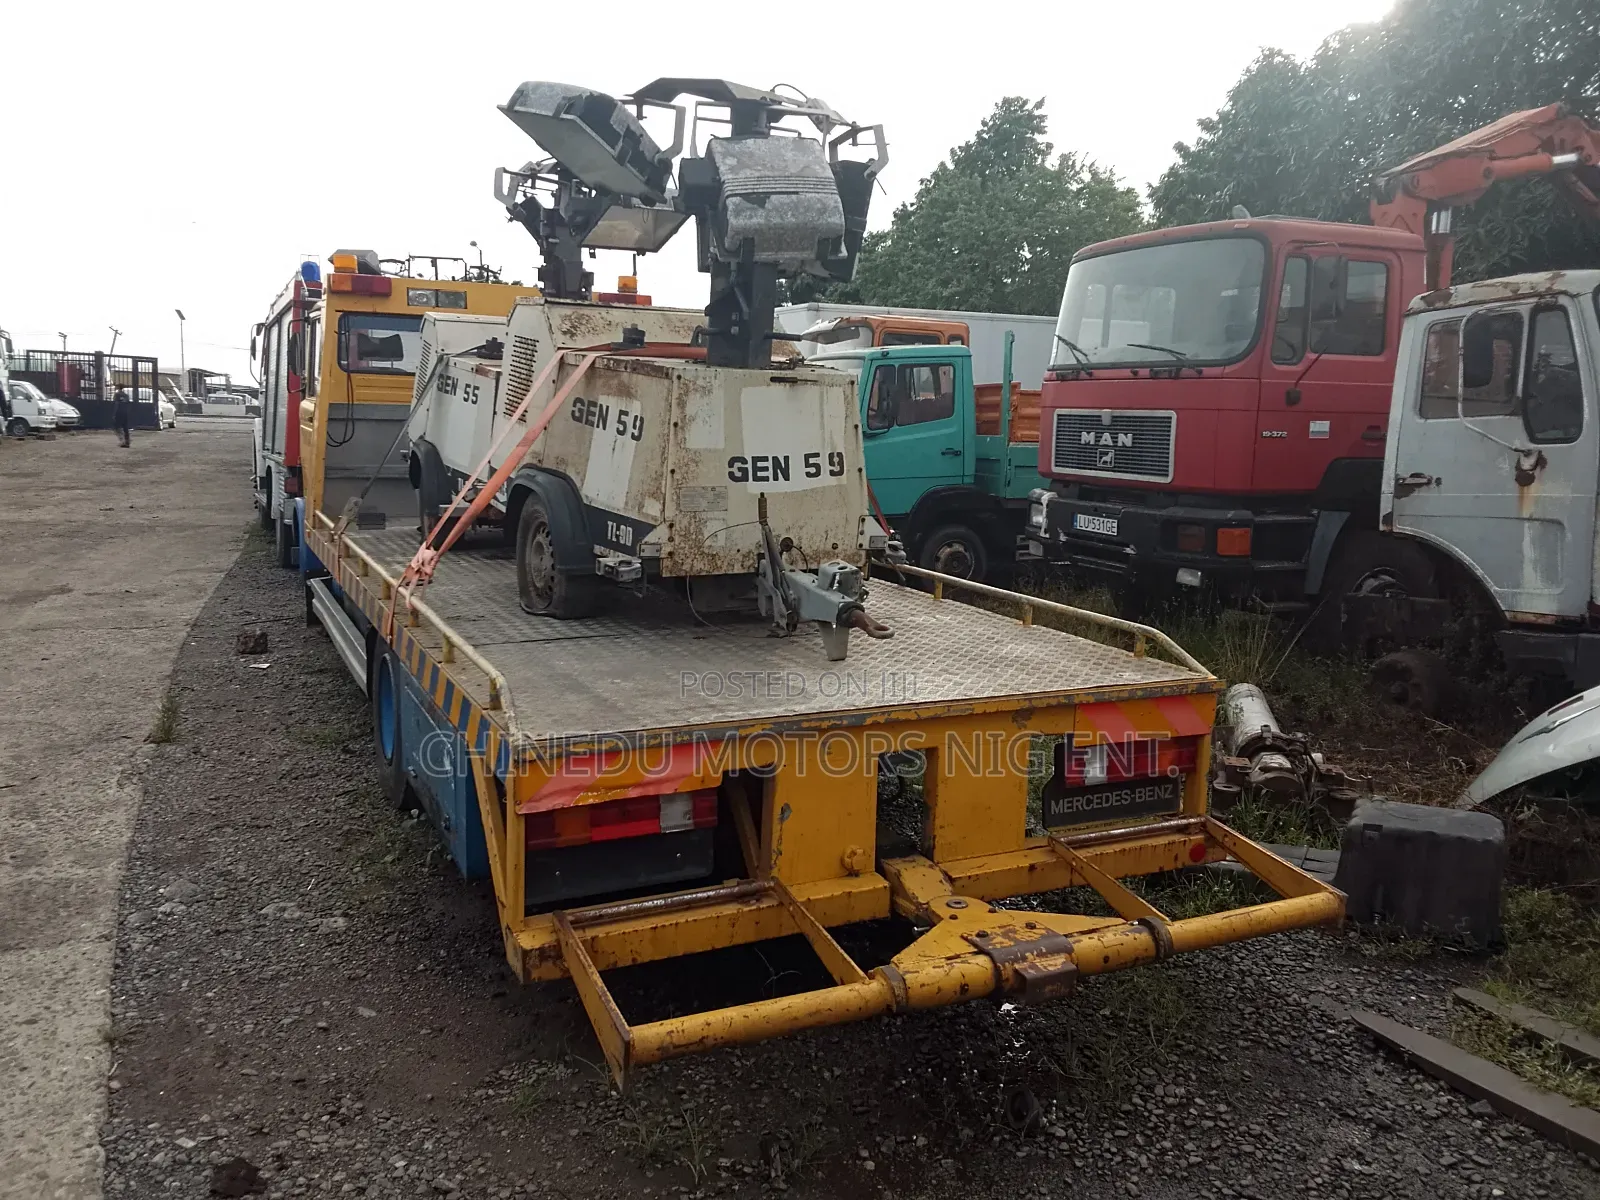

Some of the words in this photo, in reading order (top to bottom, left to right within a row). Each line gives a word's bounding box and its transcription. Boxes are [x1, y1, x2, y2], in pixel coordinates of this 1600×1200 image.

[437, 373, 458, 396] GEN
[463, 383, 480, 405] 55
[571, 396, 609, 431] GEN
[616, 409, 645, 442] 59
[1080, 431, 1133, 447] MAN
[727, 455, 791, 483] GEN
[804, 451, 846, 479] 59
[1050, 784, 1174, 816] MERCEDES-BENZ
